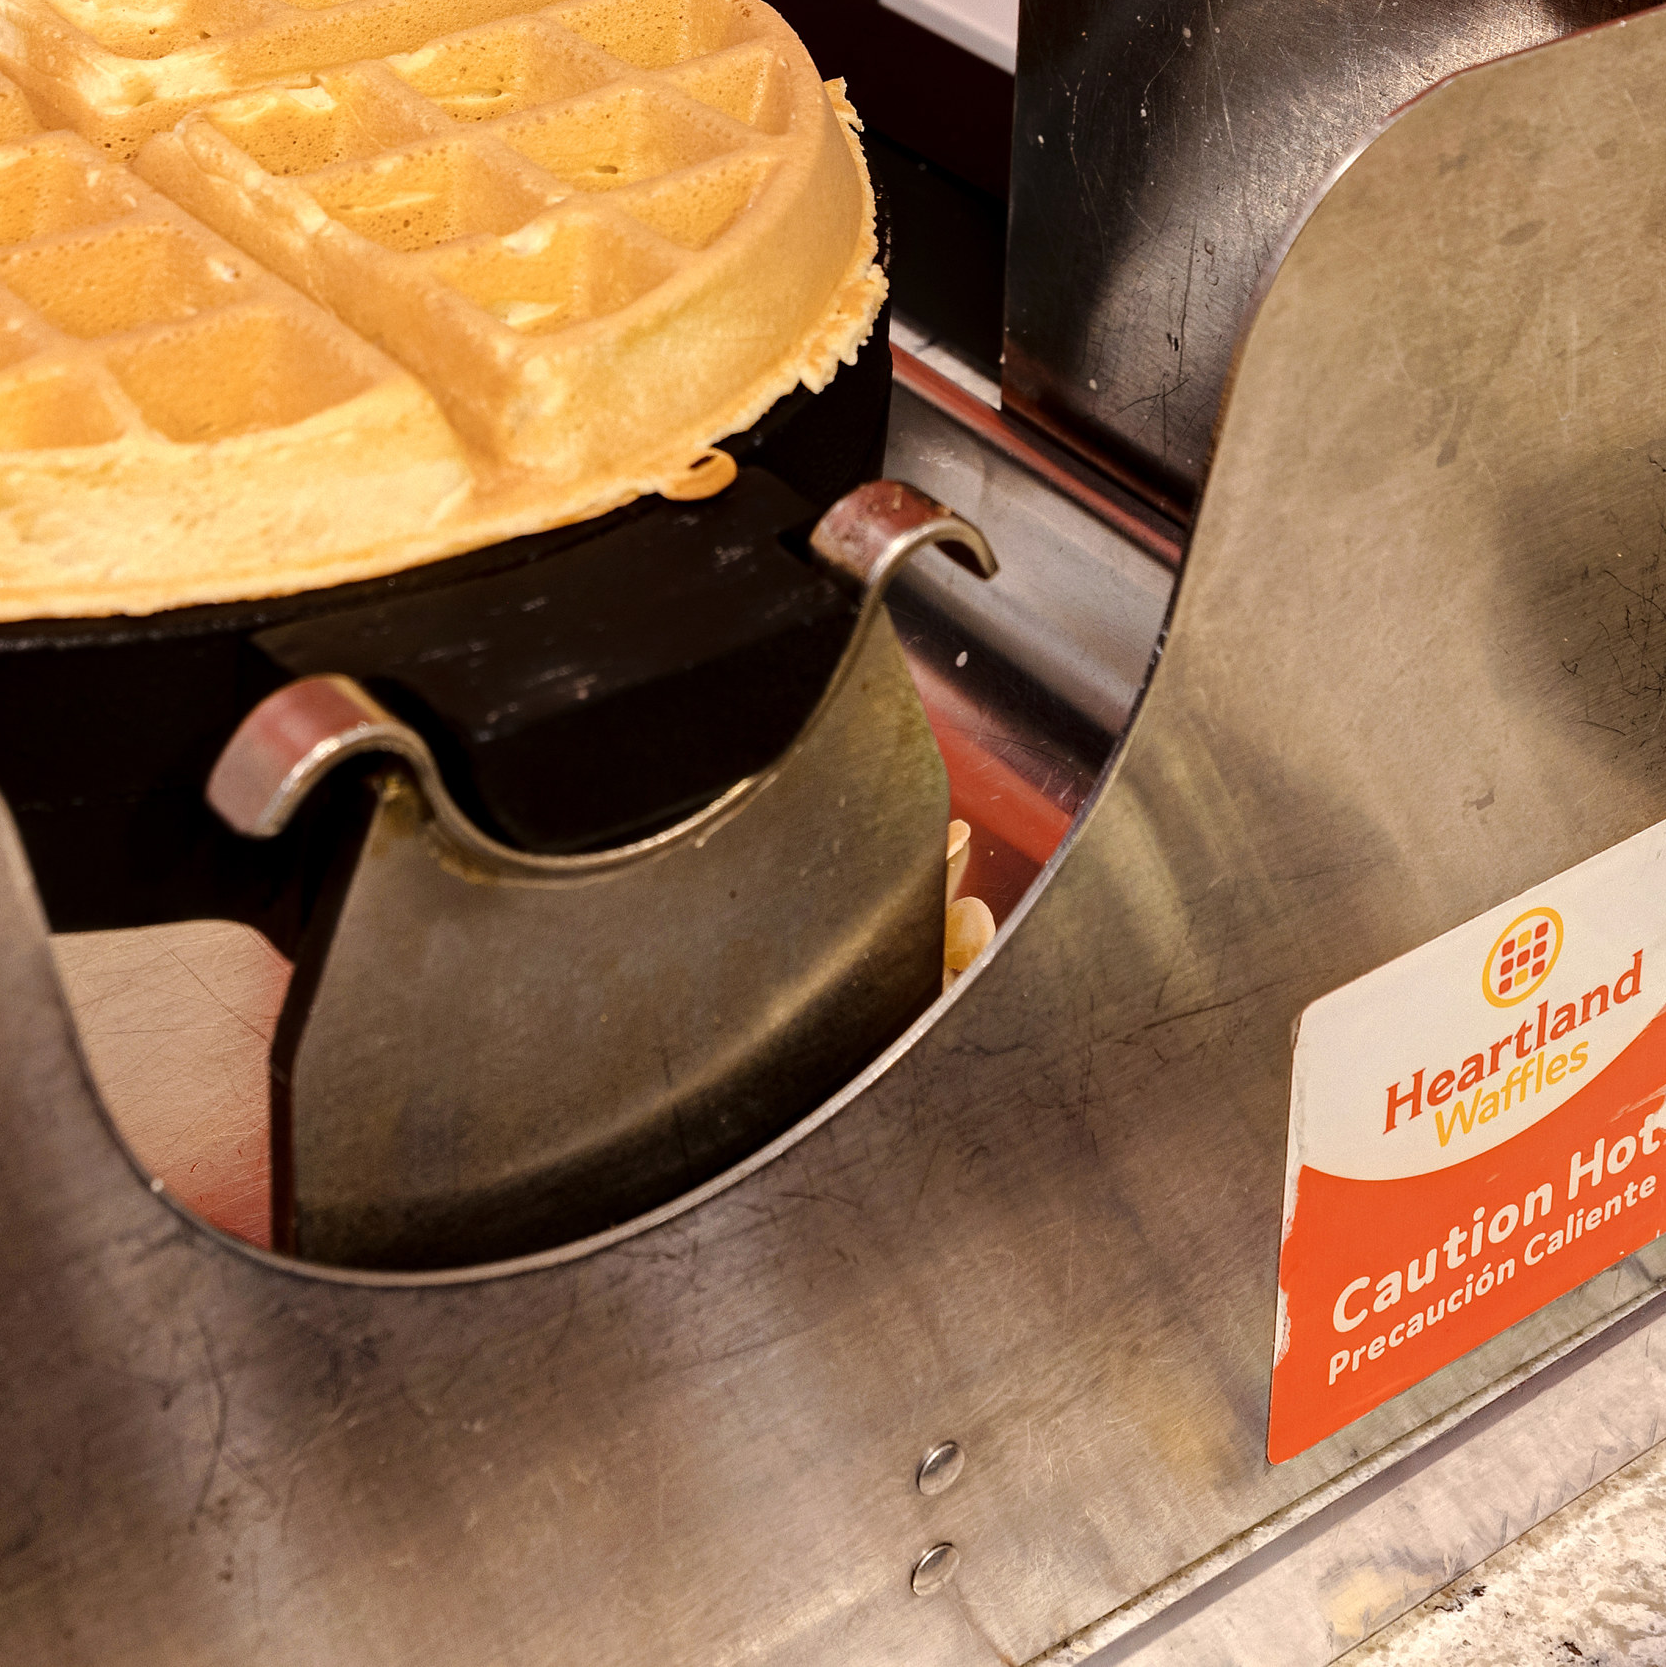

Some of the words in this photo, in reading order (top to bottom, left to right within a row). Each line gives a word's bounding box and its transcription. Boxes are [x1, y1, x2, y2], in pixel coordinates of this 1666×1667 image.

[1383, 949, 1643, 1135] Heartland
[1434, 1039, 1590, 1147] Waffles
[1327, 1261, 1515, 1386] Precaución
[1523, 1171, 1657, 1268] Caliente
[1332, 1180, 1553, 1334] Caution
[1568, 1112, 1662, 1200] Hot
